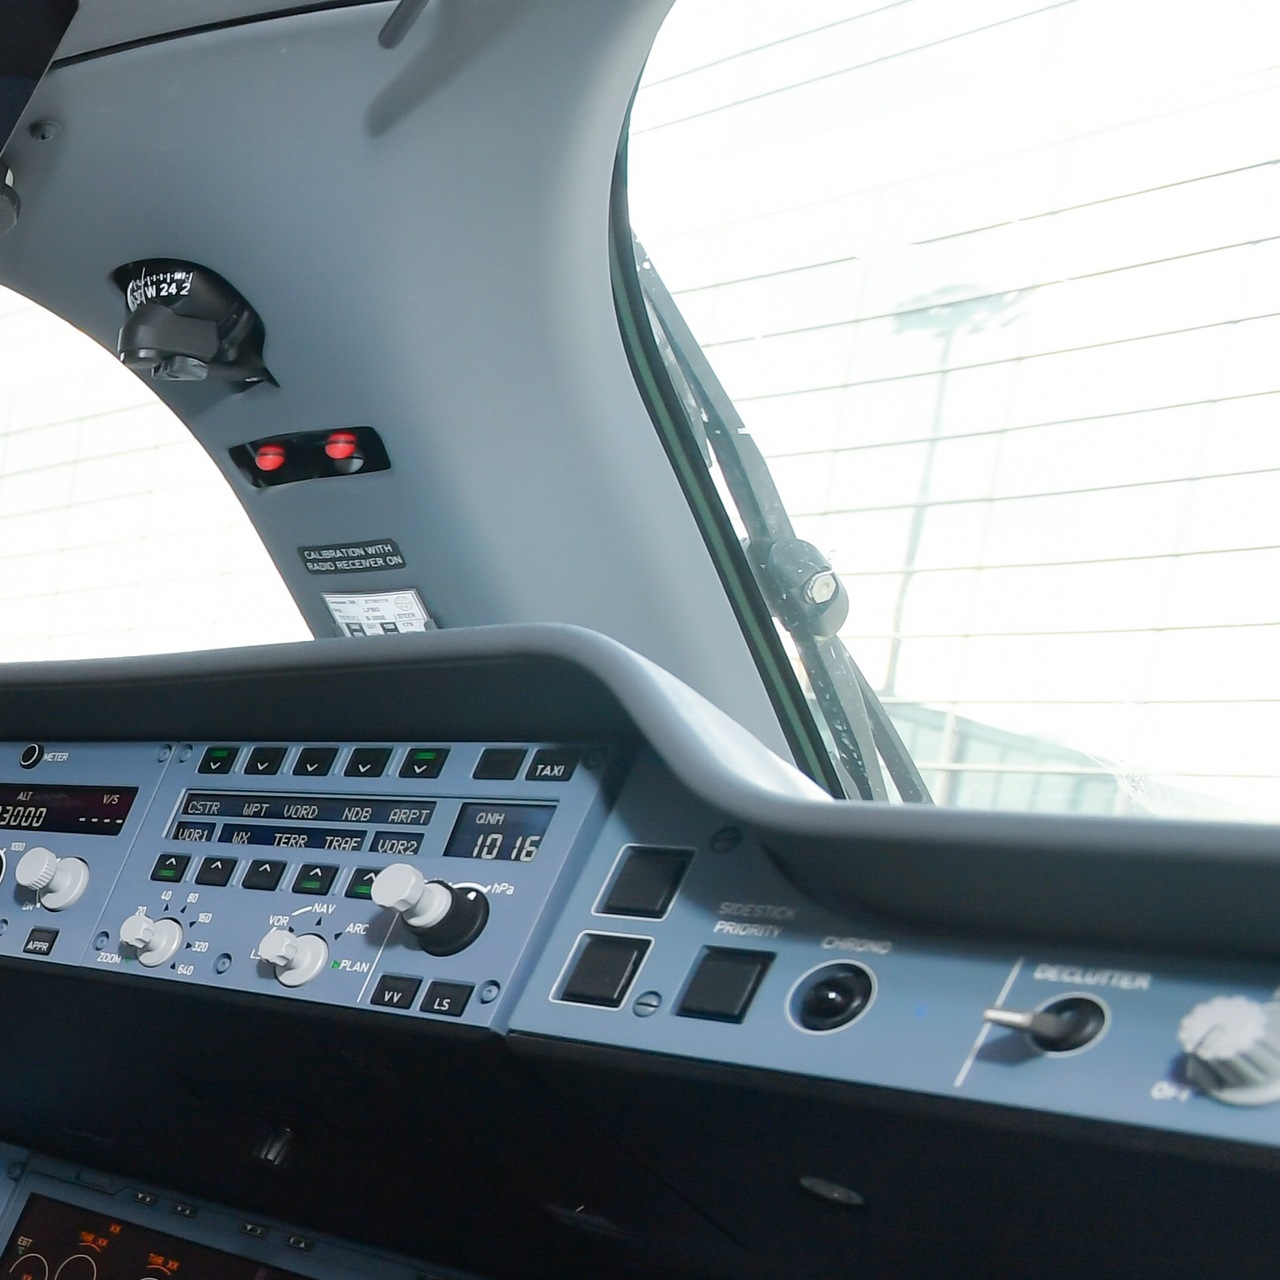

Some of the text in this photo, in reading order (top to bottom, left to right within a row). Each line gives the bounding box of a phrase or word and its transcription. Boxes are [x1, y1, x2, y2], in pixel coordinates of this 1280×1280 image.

[159, 284, 177, 296] 24
[304, 543, 392, 560] CALIBRATION WITH
[306, 555, 403, 571] RADIO RECEIVER ON
[43, 752, 68, 762] METER
[535, 765, 565, 776] TAXI
[17, 791, 32, 800] ALT
[103, 794, 120, 804] V/S
[188, 802, 430, 823] CSTR WPT VORD NDB ARPT
[476, 812, 505, 825] QNH
[178, 828, 208, 842] VOR1
[274, 833, 308, 848] TERR
[324, 836, 361, 851] TRAF
[378, 839, 417, 855] VOR2
[472, 834, 540, 862] 1016
[491, 882, 515, 894] hPa
[161, 890, 172, 900] 40
[312, 903, 336, 915] NAV
[718, 901, 800, 920] SIDESTICK
[198, 912, 212, 923] 160
[269, 915, 289, 926] VOR
[345, 923, 369, 935] ARC
[713, 920, 783, 938] PRIORITY
[27, 941, 49, 951] APPR
[192, 941, 208, 952] 320
[97, 952, 121, 963] ZOOM
[177, 964, 193, 975] 640
[339, 960, 371, 973] PLAN
[1034, 963, 1151, 990] DECLUTTER
[384, 991, 402, 1003] VV
[434, 998, 451, 1011] LS
[17, 1236, 33, 1249] EGT
